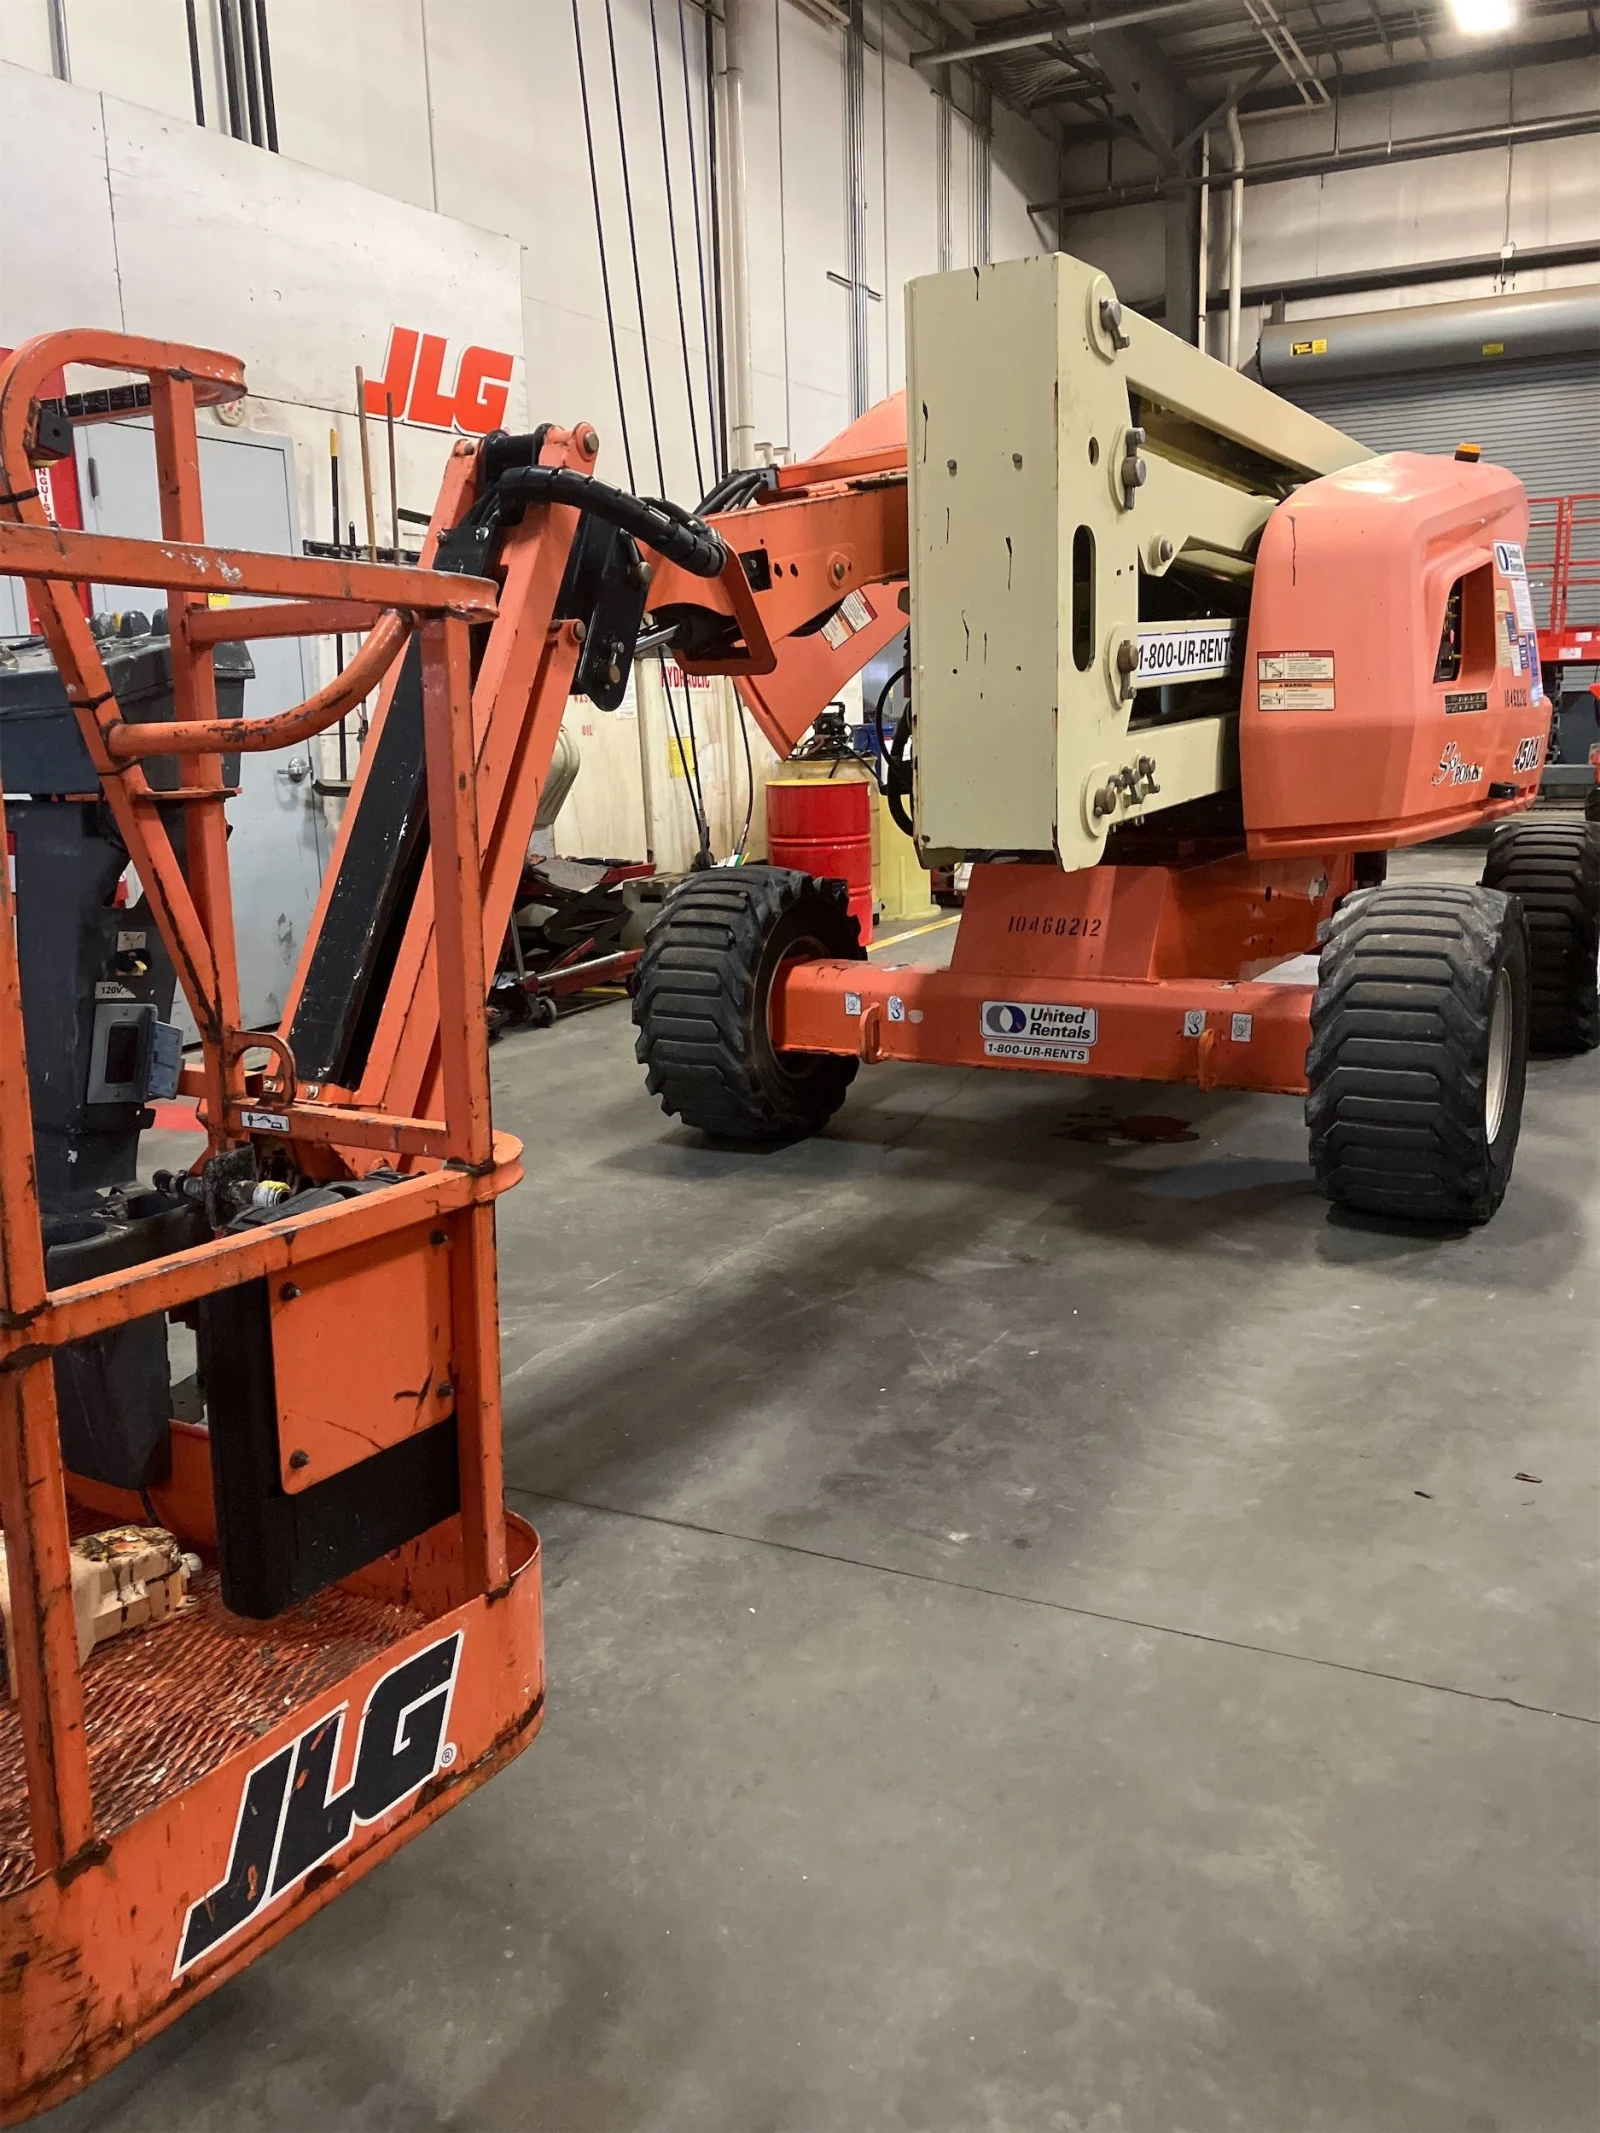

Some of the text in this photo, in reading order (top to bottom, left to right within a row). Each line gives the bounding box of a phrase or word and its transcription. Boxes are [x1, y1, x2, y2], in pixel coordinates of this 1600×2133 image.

[360, 326, 515, 435] JLG
[581, 725, 594, 736] OIL
[1512, 734, 1545, 774] 450AJ
[1008, 915, 1102, 937] 10468212
[101, 986, 123, 995] 120V
[1030, 1007, 1086, 1025] United
[1029, 1022, 1091, 1039] Rentals
[987, 1043, 1086, 1061] 1-800-UR-RENTS
[171, 1629, 464, 1981] JLG
